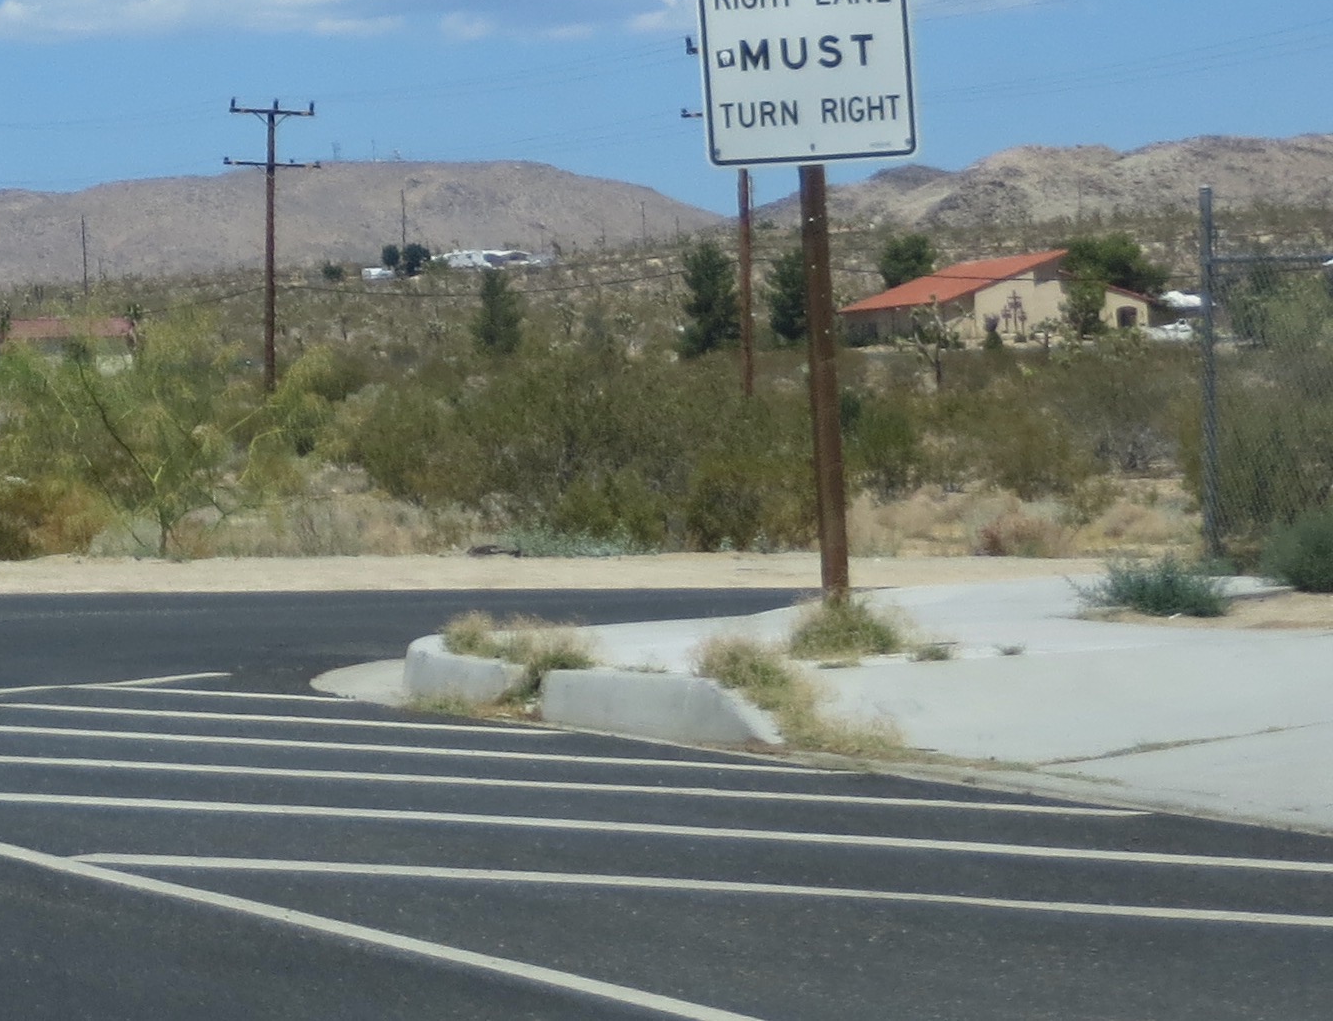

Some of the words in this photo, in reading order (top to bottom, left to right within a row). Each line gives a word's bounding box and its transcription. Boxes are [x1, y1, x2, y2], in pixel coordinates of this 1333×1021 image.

[739, 33, 873, 71] MUST
[719, 99, 799, 128] TURN
[821, 94, 900, 124] RIGHT
